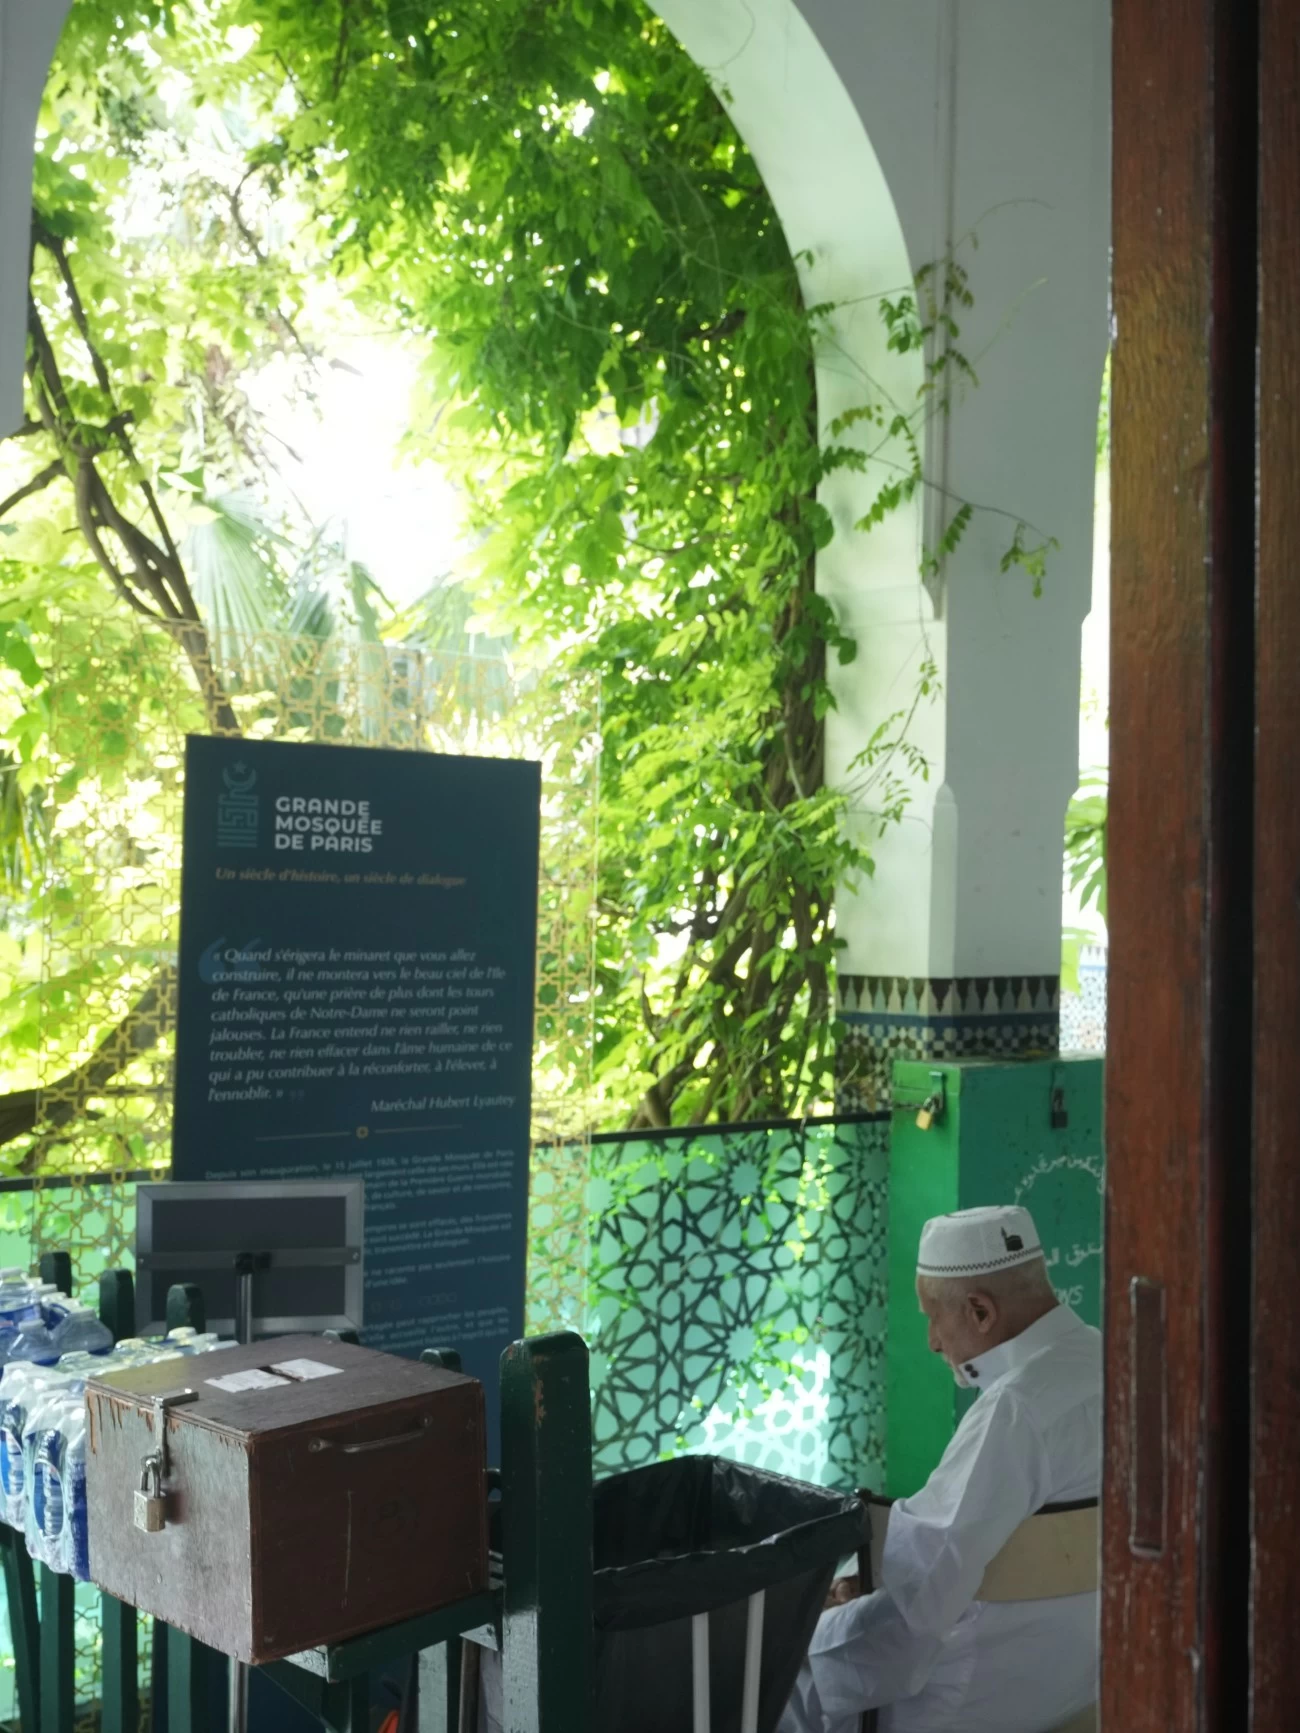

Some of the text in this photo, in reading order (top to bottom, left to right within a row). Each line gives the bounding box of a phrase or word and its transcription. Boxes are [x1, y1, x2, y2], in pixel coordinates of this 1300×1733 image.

[275, 796, 370, 816] GRANDE
[275, 815, 383, 835] MOSQUÉE
[275, 834, 373, 853] DE PARIS
[216, 868, 236, 880] Un
[239, 868, 276, 881] siècle
[343, 872, 360, 882] un
[363, 871, 394, 883] siècle
[398, 872, 415, 884] de
[417, 873, 466, 888] dialogue
[224, 948, 273, 964] Quand
[274, 948, 325, 966] s'érigera
[329, 948, 342, 961] le
[344, 948, 390, 961] minaret
[393, 952, 417, 966] que
[420, 952, 447, 961] vous
[450, 948, 476, 961] allez
[212, 969, 282, 982] construire,
[286, 967, 295, 981] il
[297, 971, 314, 981] ne
[317, 969, 369, 981] montera
[372, 971, 397, 980] vers
[399, 966, 411, 979] le
[414, 966, 444, 980] beau
[446, 966, 467, 980] ciel
[469, 966, 485, 979] de
[211, 985, 494, 1004] de France, qu'une prière de plus dont les tours
[210, 1004, 478, 1025] catholiques de Notre-Dame ne seront point
[208, 1027, 267, 1046] jalouses.
[271, 1027, 285, 1040] La
[289, 1026, 331, 1039] France
[334, 1021, 379, 1038] entend
[380, 1026, 396, 1037] ne
[399, 1023, 422, 1036] rien
[463, 1025, 478, 1034] ne
[480, 1021, 503, 1033] rien
[210, 1039, 513, 1061] troubler, ne rien effacer dans l'âme humaine de ce
[208, 1068, 231, 1085] qui
[234, 1071, 242, 1080] a
[245, 1069, 264, 1084] pu
[268, 1064, 335, 1080] contribuer
[337, 1063, 345, 1076] à
[348, 1061, 360, 1076] la
[435, 1060, 442, 1072] à
[490, 1056, 497, 1070] à
[208, 1086, 272, 1102] l'ennoblir.
[371, 1094, 516, 1112] Maréchal Hubert Lyautey
[205, 1170, 237, 1180] Depuis
[240, 1169, 256, 1177] son
[322, 1162, 331, 1170] le
[348, 1159, 372, 1170] juillet
[411, 1155, 441, 1164] Grande
[444, 1152, 480, 1161] Mosquée
[483, 1151, 493, 1159] de
